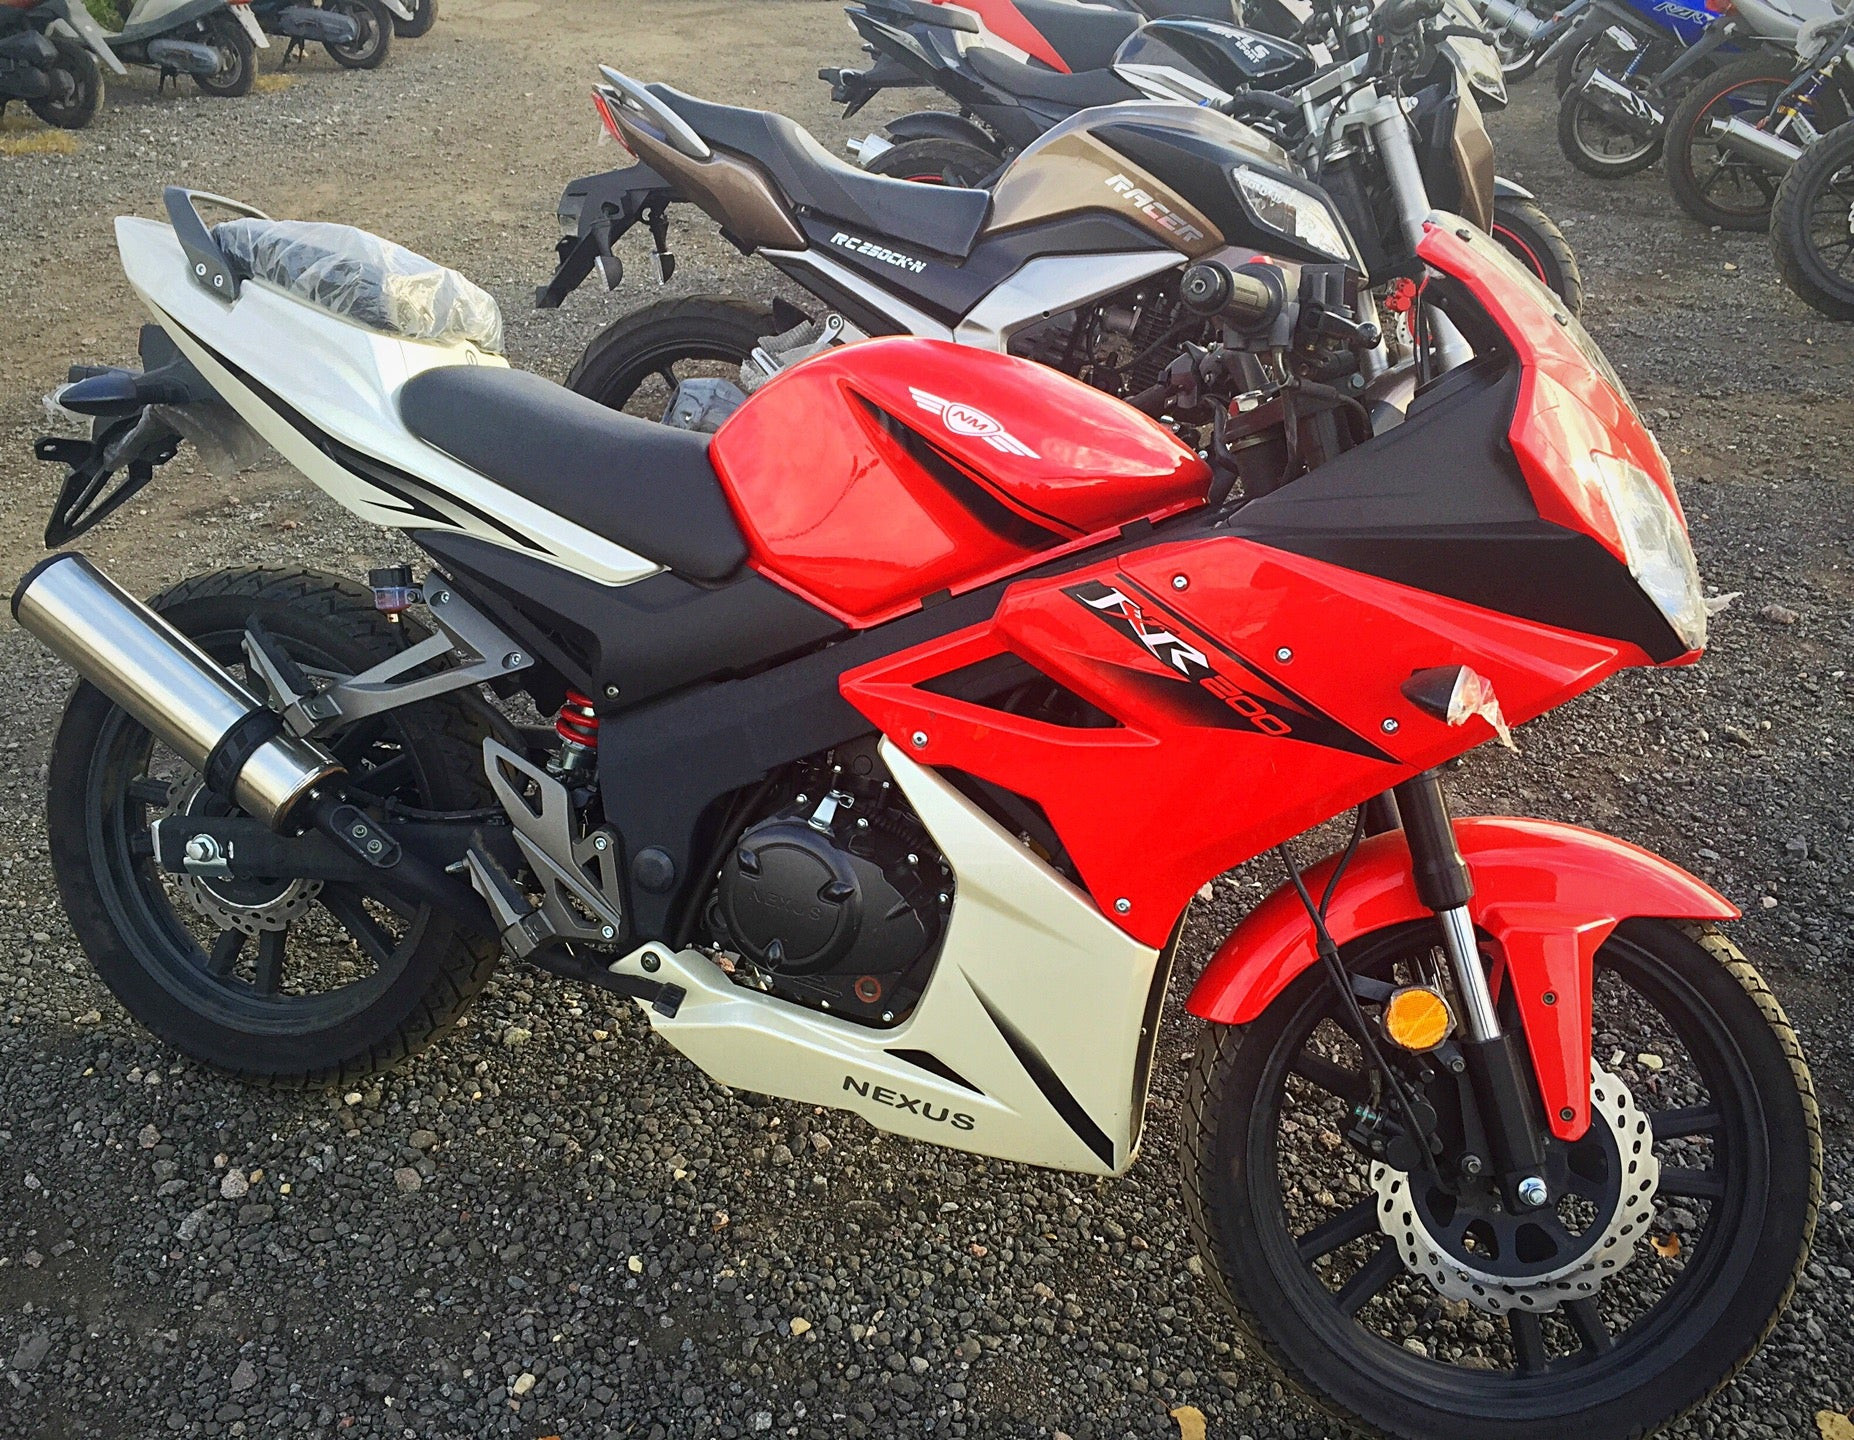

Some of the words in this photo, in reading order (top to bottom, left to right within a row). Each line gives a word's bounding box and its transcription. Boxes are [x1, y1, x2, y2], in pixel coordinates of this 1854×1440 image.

[1103, 172, 1204, 242] RACER
[830, 232, 862, 250] RC
[952, 410, 989, 431] NM
[1199, 674, 1293, 737] 200
[746, 885, 822, 921] NEXUS
[842, 1075, 977, 1131] NEXUS
